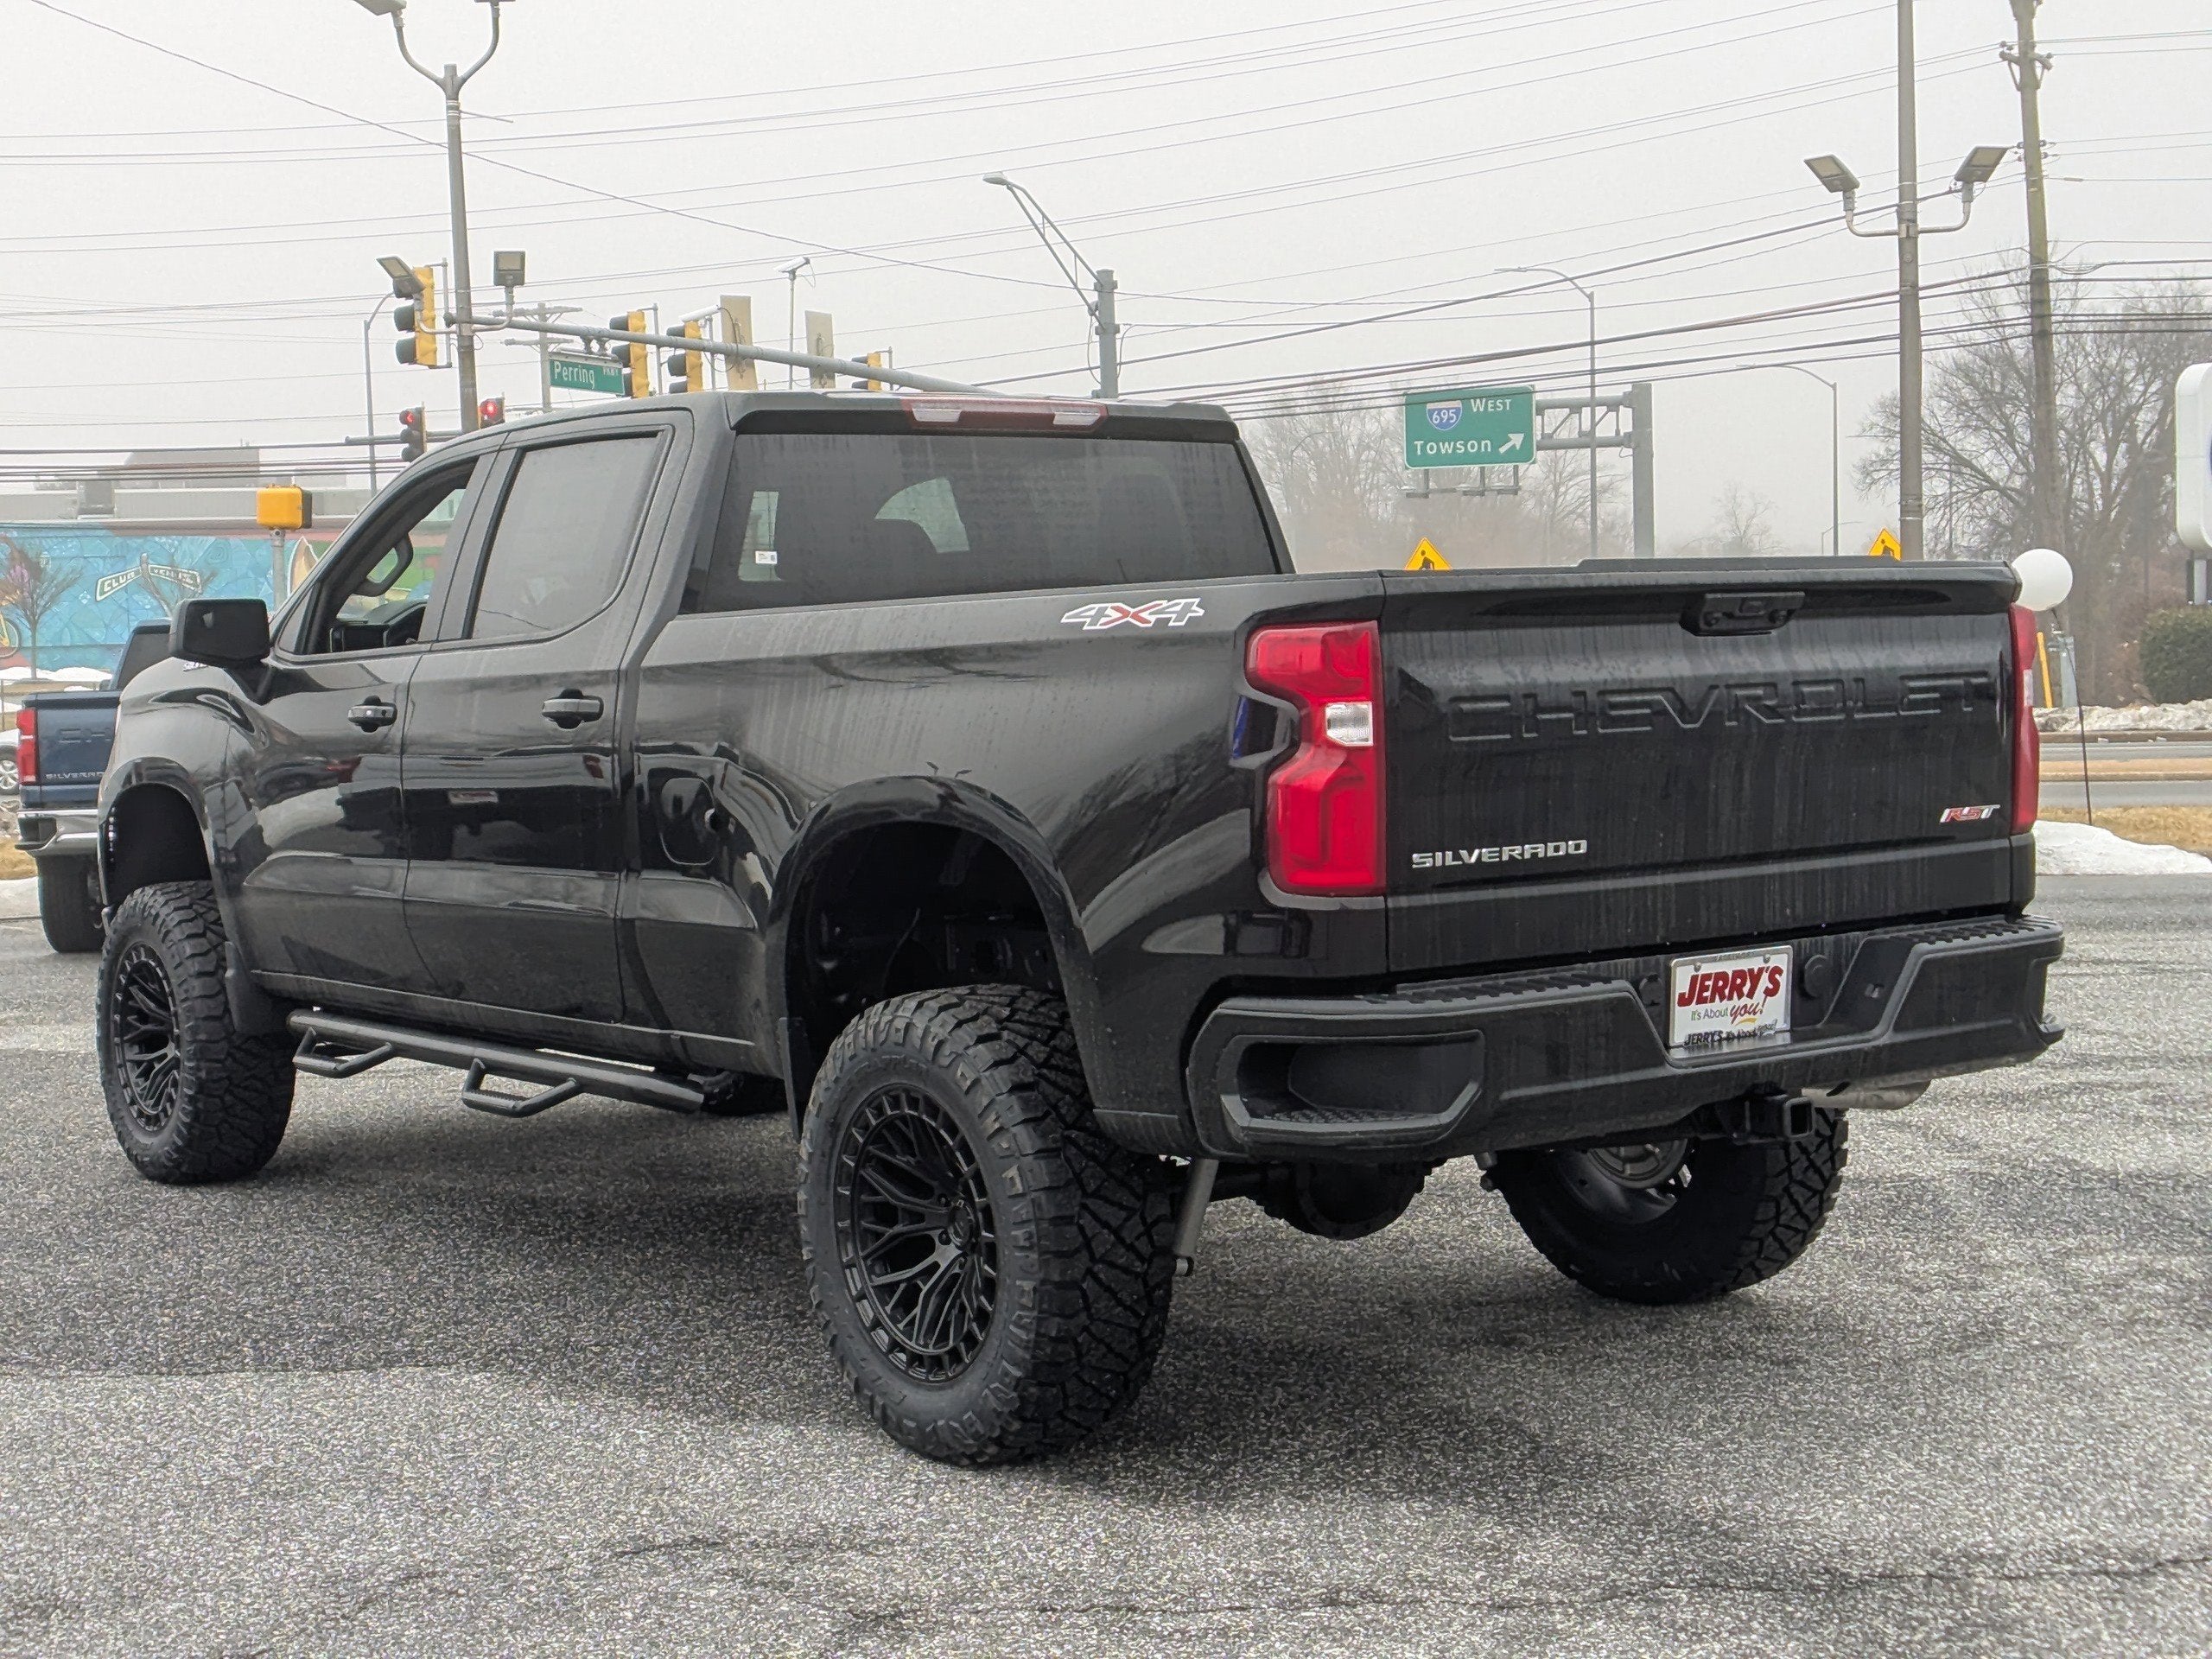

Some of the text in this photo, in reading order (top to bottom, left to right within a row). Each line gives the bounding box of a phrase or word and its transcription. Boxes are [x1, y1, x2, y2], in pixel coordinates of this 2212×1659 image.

[554, 361, 594, 389] Perring
[1432, 409, 1457, 424] 695
[1449, 671, 1988, 741] CHEVROLET
[1939, 804, 2000, 823] RST
[1411, 839, 1587, 868] SILVERADO
[1677, 965, 1783, 1007] JERRY'S
[1703, 1007, 1728, 1020] About
[1729, 995, 1767, 1025] you!
